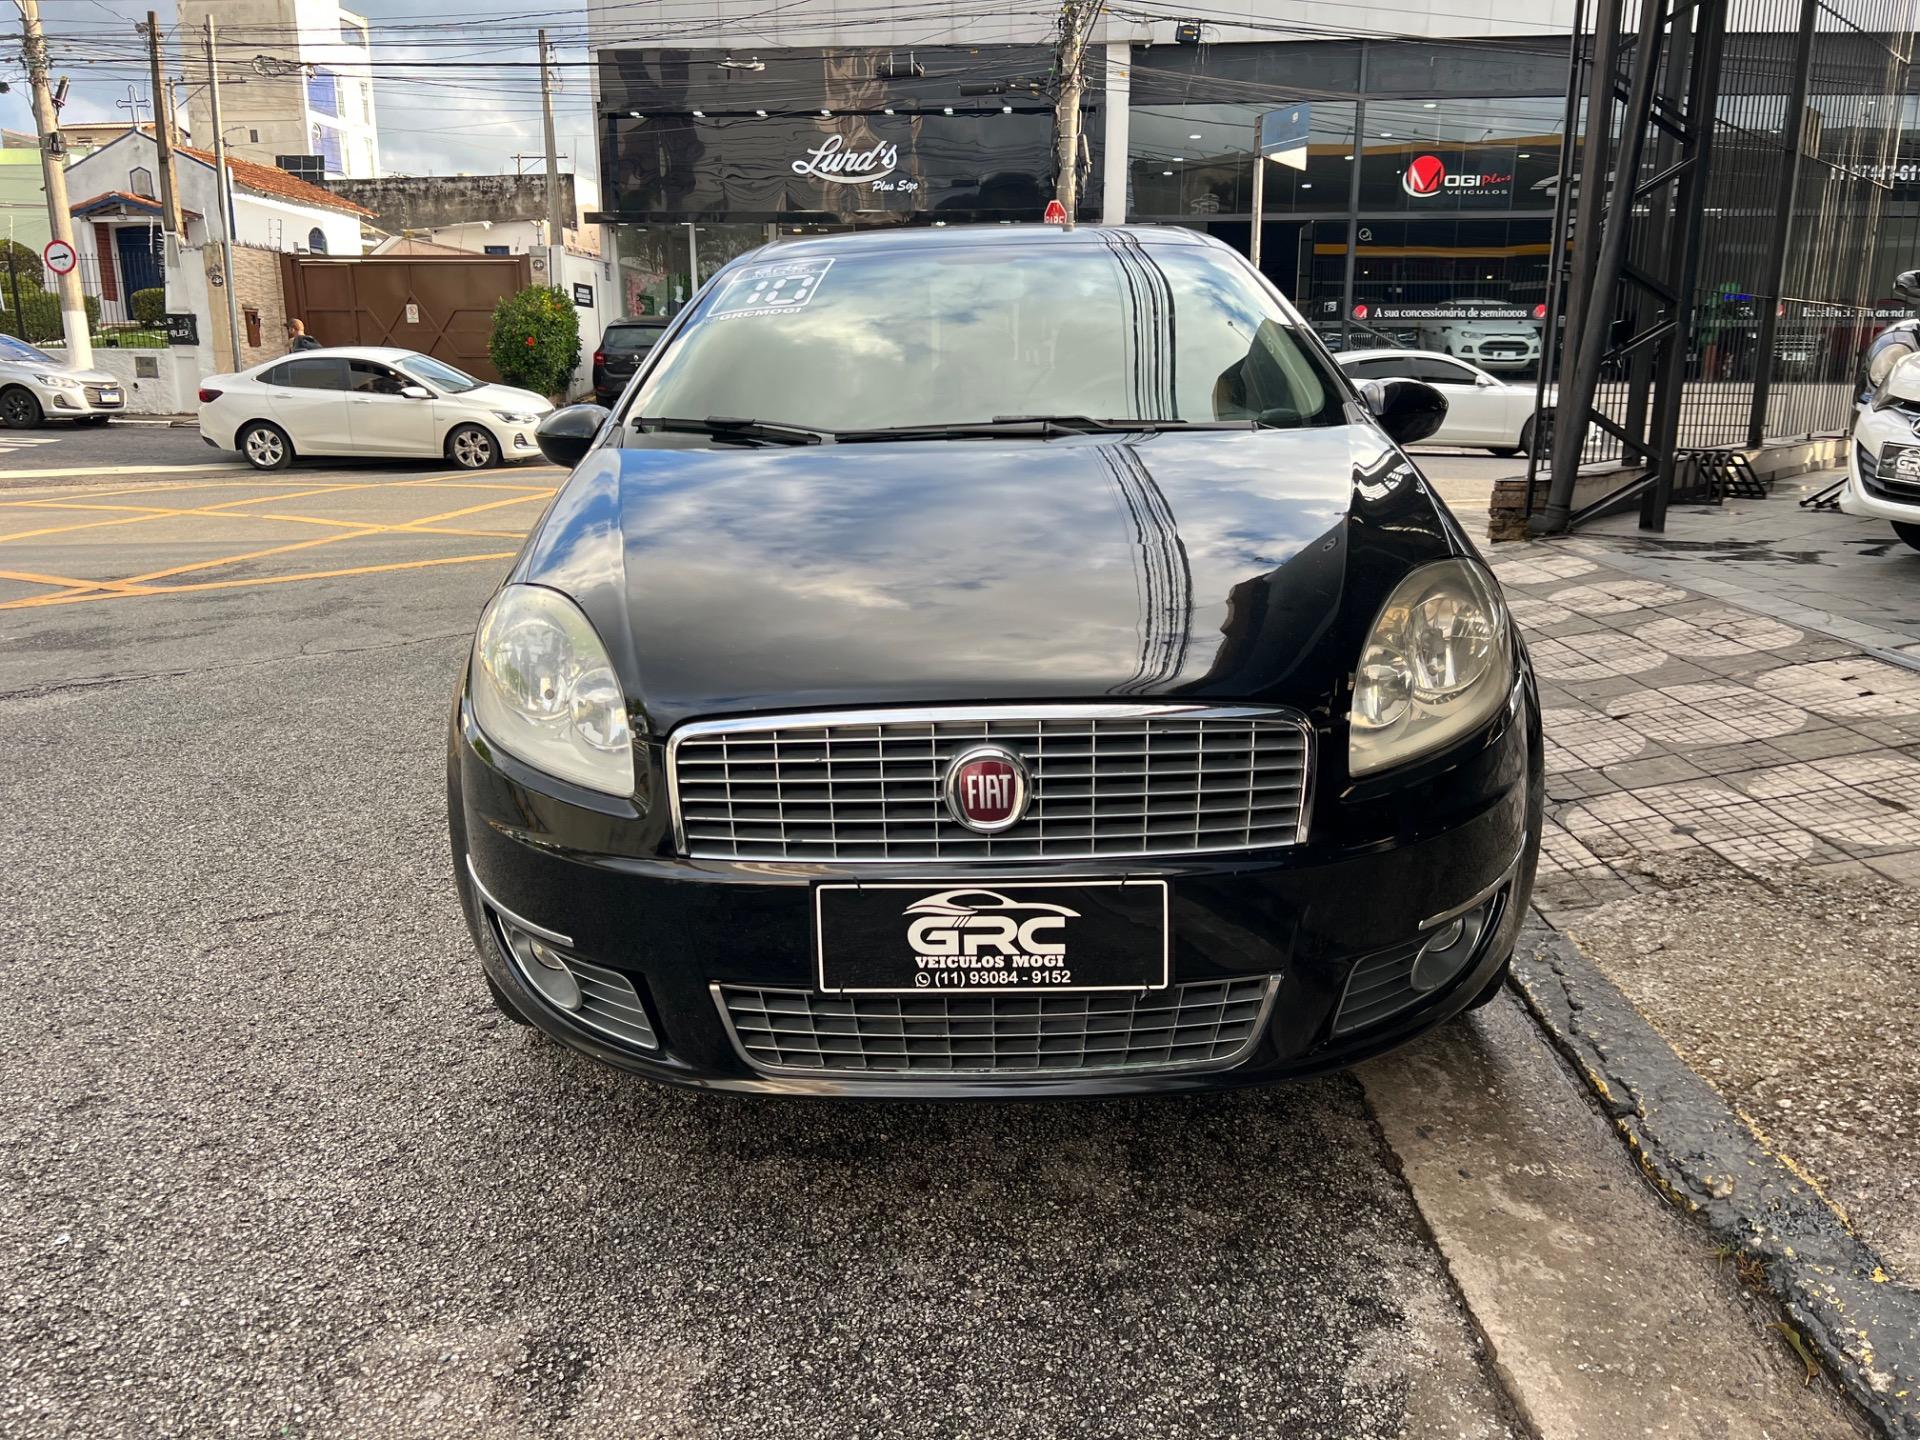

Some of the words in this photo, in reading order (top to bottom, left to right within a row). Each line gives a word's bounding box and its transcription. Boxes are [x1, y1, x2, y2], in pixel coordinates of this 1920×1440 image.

[791, 134, 898, 176] Lurd's
[871, 180, 895, 193] Plus
[896, 180, 919, 193] Size
[746, 274, 816, 306] 10
[1373, 307, 1383, 318] A
[1384, 309, 1400, 318] sua
[1401, 307, 1466, 318] concessionária
[1467, 307, 1479, 318] de
[966, 773, 1012, 810] FIAT
[907, 915, 1066, 956] GRC
[914, 955, 1005, 969] VEICULOS
[1012, 954, 1065, 968] MOGI
[934, 970, 966, 988] (11)
[969, 970, 1019, 985] 93084
[1031, 969, 1072, 984] 9152
